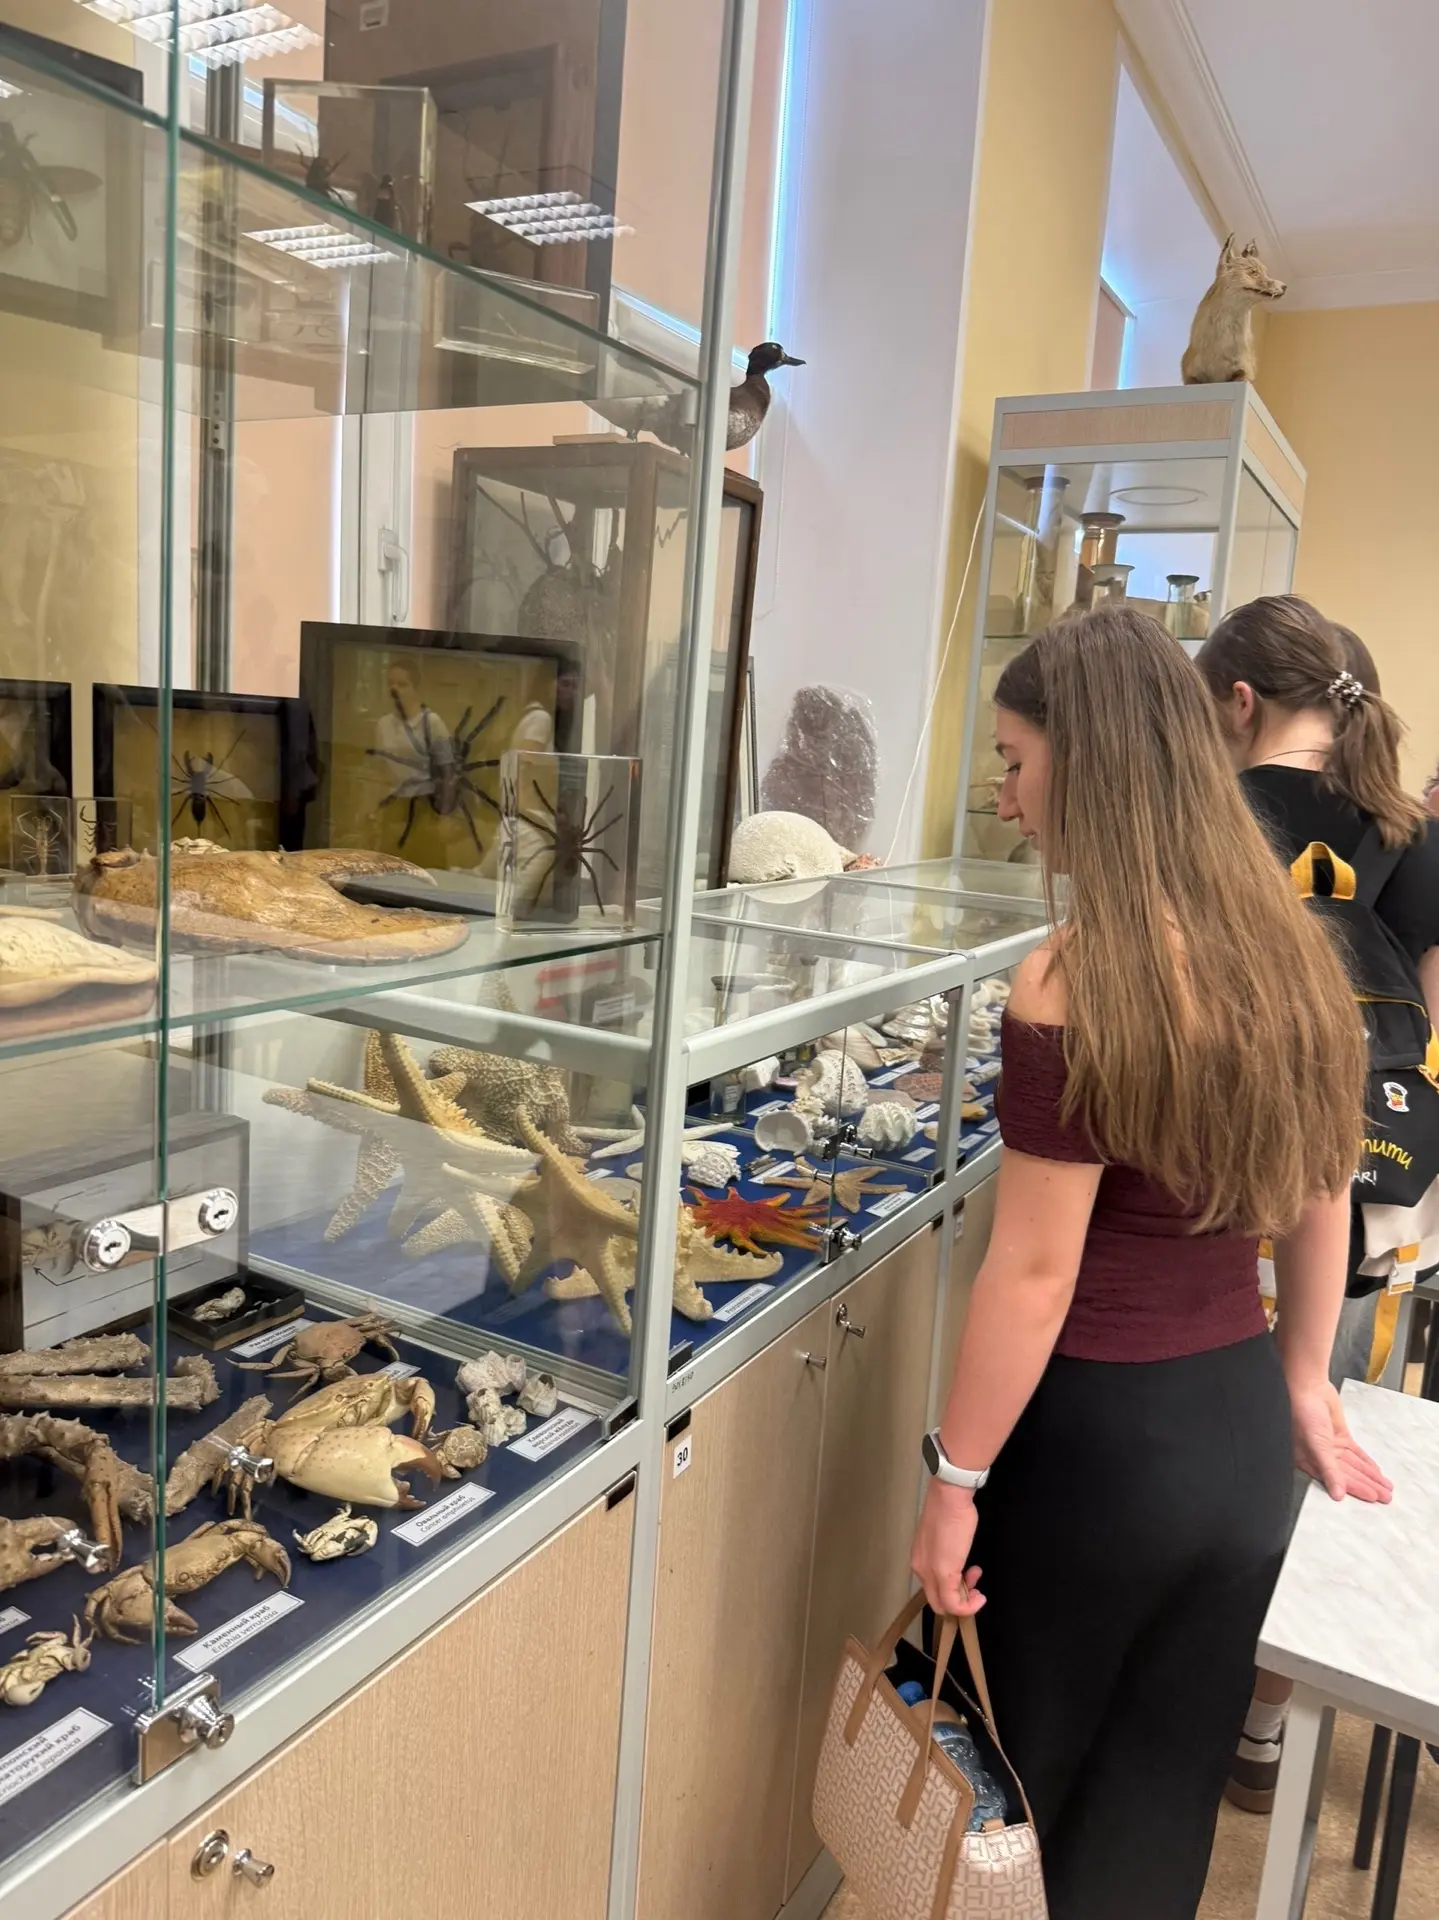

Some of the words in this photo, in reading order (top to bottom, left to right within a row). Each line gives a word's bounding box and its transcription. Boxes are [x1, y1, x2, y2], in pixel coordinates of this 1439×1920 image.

[677, 1446, 688, 1466] 30
[415, 1504, 449, 1528] Овальный
[450, 1494, 466, 1507] краб
[420, 1517, 441, 1533] Cancer
[202, 1617, 249, 1649] Каменный
[250, 1604, 271, 1621] краб
[211, 1631, 241, 1654] Eriphia
[242, 1610, 279, 1636] verrucosa
[54, 1724, 82, 1744] краб
